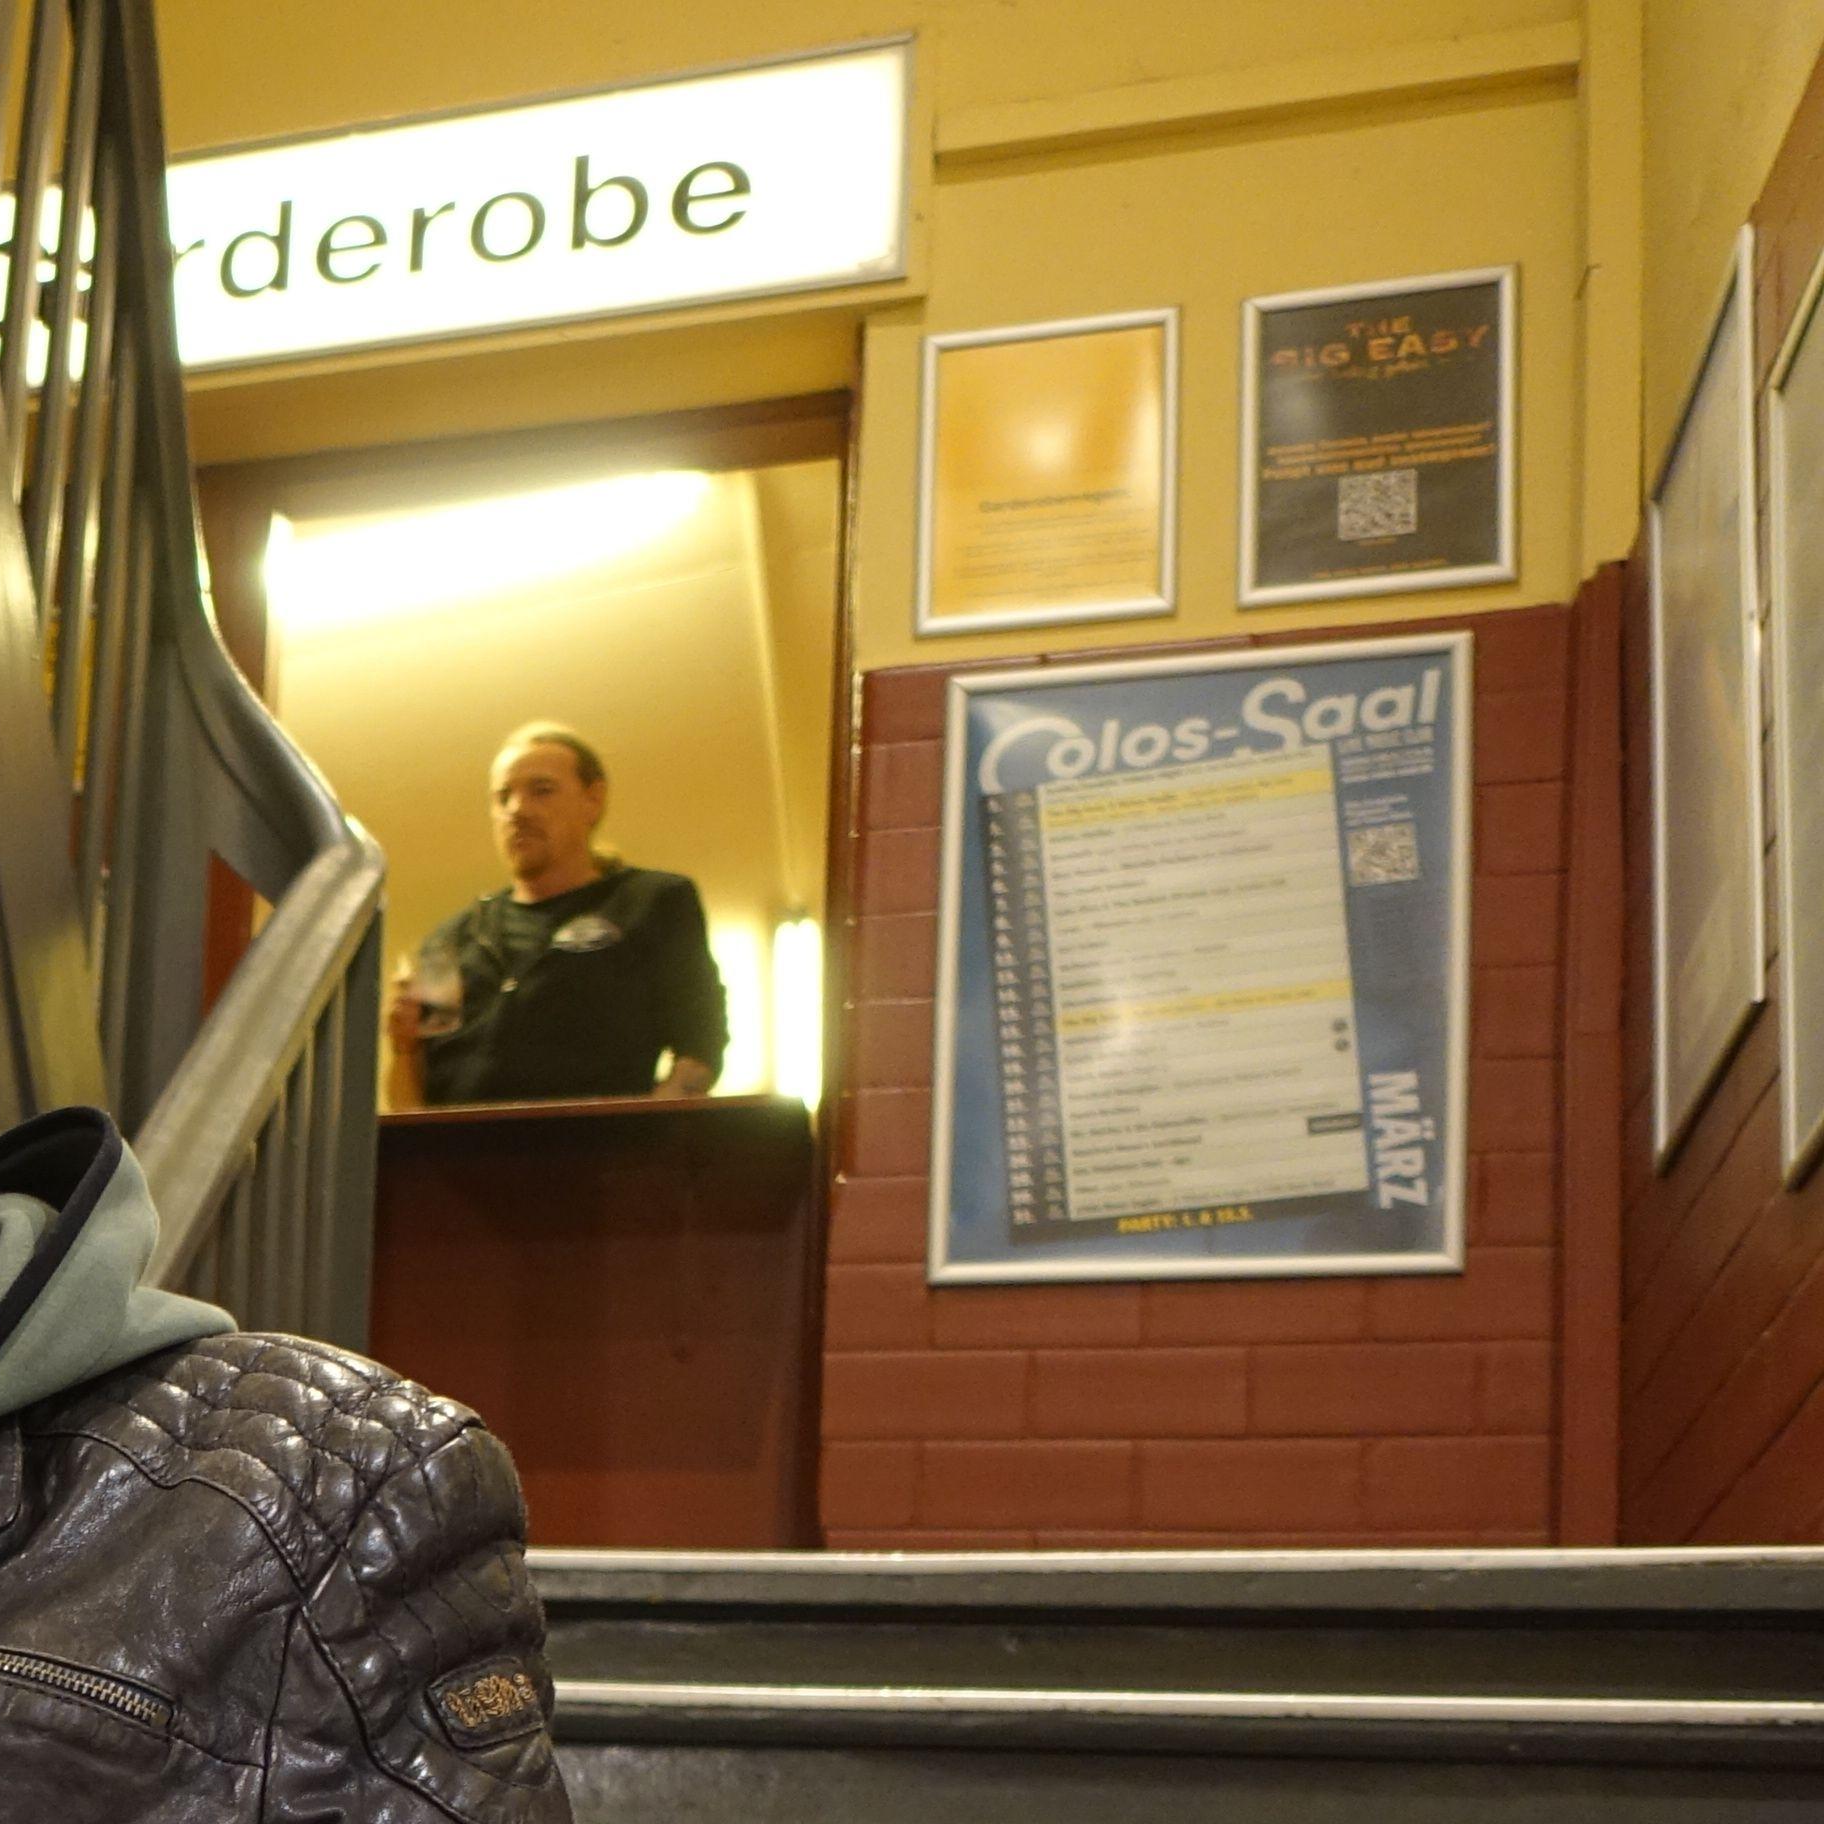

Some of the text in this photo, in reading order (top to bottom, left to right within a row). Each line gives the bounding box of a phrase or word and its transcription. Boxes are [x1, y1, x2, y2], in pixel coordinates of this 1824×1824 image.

[1367, 323, 1491, 362] EASY
[979, 667, 1442, 794] Colos-Saal
[1367, 1069, 1436, 1210] MÄRZ
